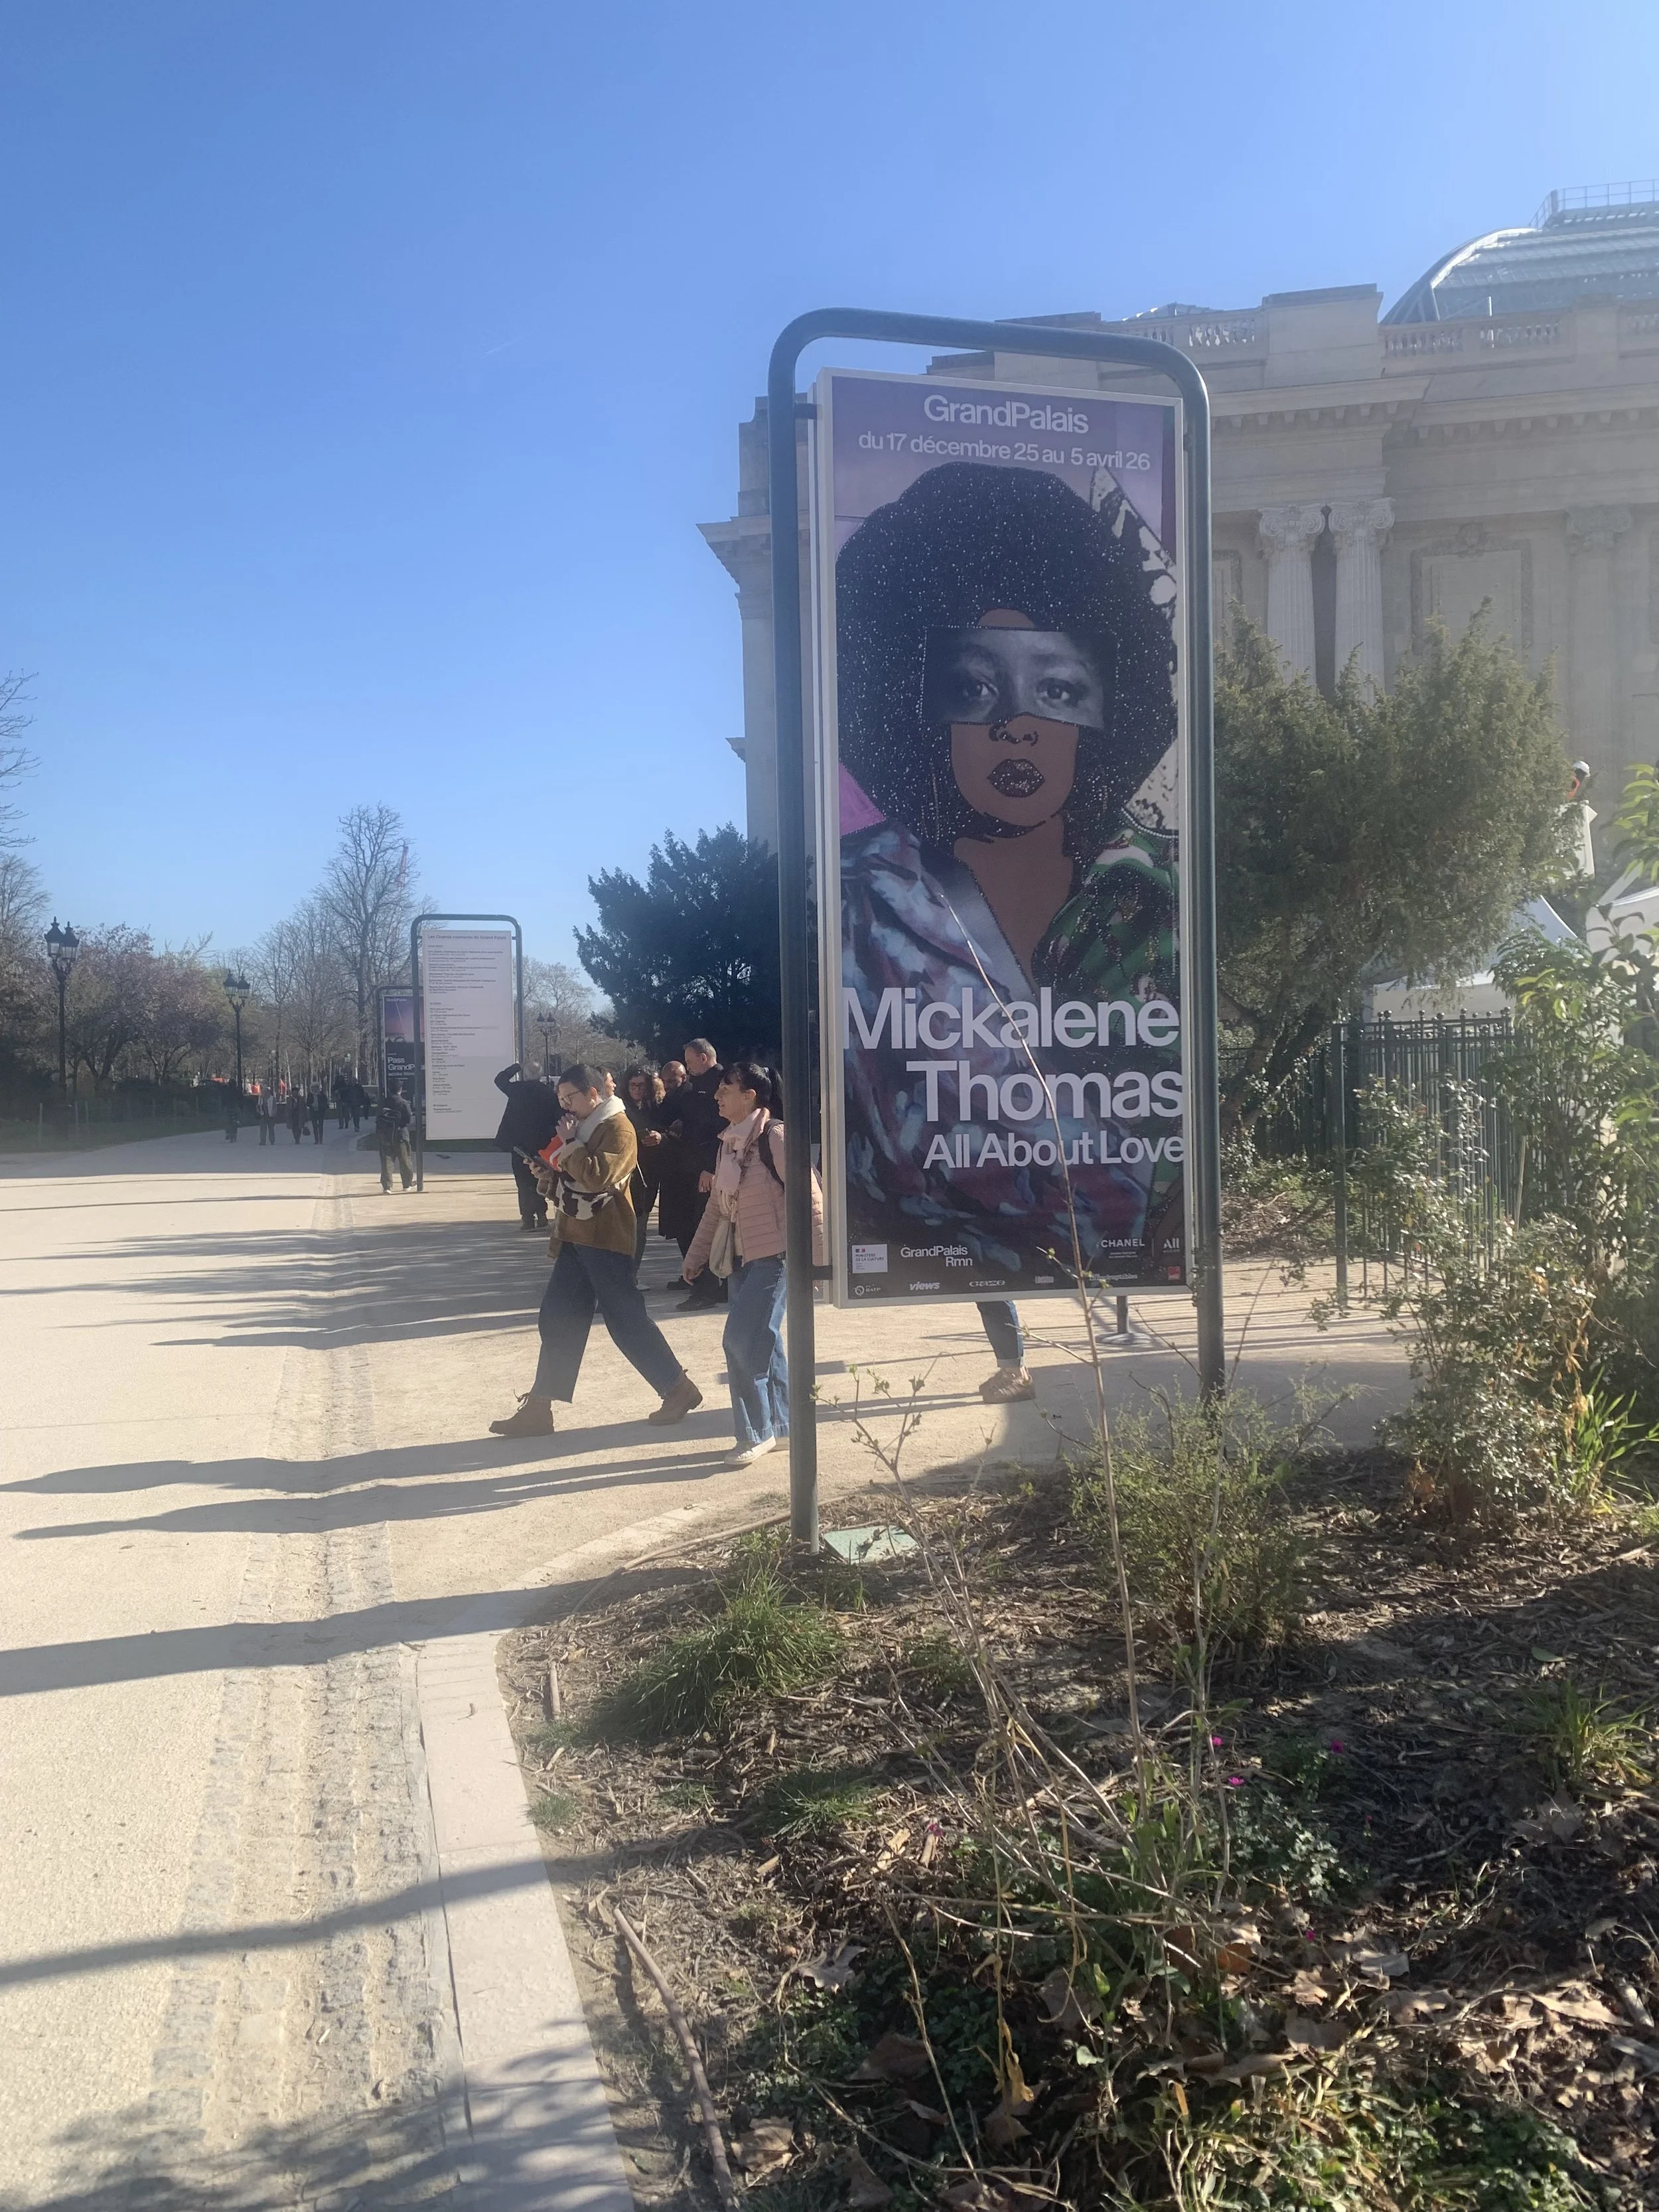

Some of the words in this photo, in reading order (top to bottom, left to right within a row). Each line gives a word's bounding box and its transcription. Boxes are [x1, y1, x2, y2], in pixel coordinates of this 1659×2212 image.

[924, 395, 1089, 434] GrandPalais
[859, 431, 883, 451] du
[887, 433, 906, 451] 17
[910, 435, 1011, 460] décembre
[1013, 443, 1039, 461] 25
[1042, 449, 1064, 464] au
[1071, 448, 1083, 465] 5
[1086, 449, 1122, 469] avril
[1126, 452, 1151, 471] 26
[842, 987, 1179, 1049] Mickalene
[906, 1061, 1183, 1122] Thomas
[923, 1134, 970, 1169] All
[976, 1132, 1094, 1168] About
[1100, 1130, 1184, 1164] Love
[900, 1245, 968, 1258] GrandPalais
[946, 1257, 973, 1268] Rmn
[1101, 1238, 1145, 1248] CHANEL
[909, 1281, 940, 1291] views
